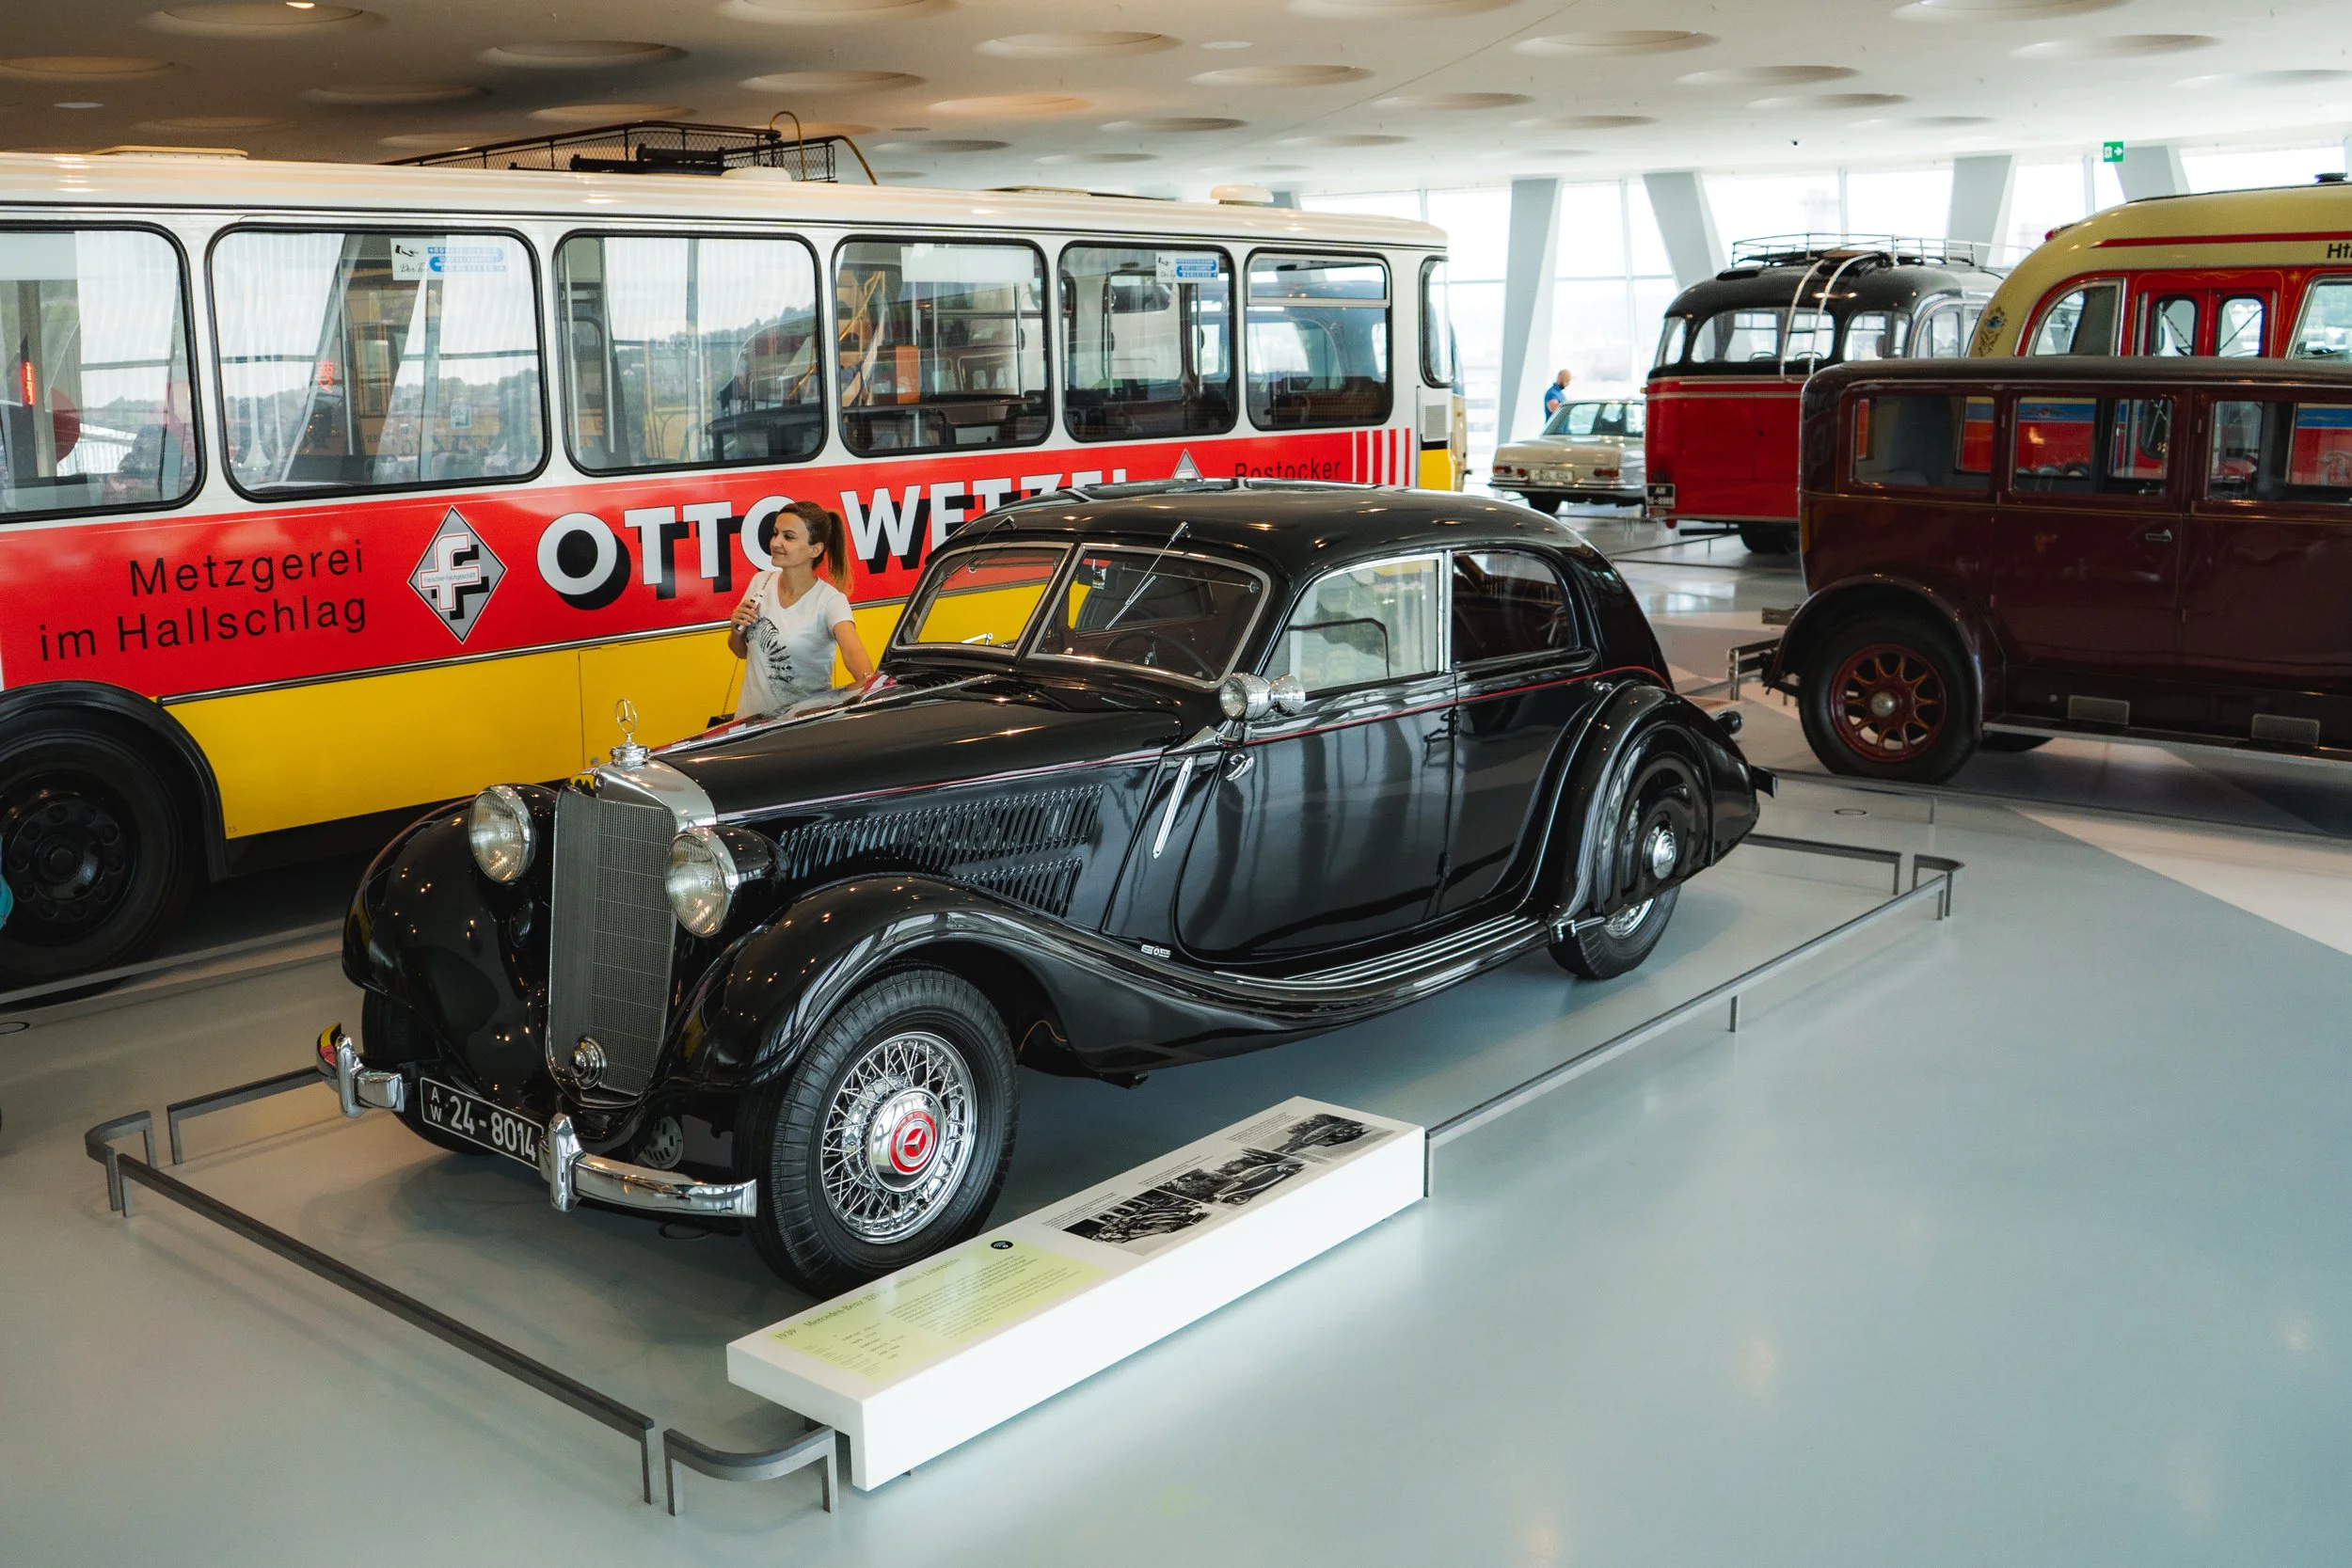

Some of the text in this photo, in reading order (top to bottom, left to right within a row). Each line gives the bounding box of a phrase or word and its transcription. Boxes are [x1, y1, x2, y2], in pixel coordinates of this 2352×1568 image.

[839, 468, 1127, 561] WET
[130, 539, 363, 596] Metzgerei
[40, 594, 366, 661] im Hallschlag
